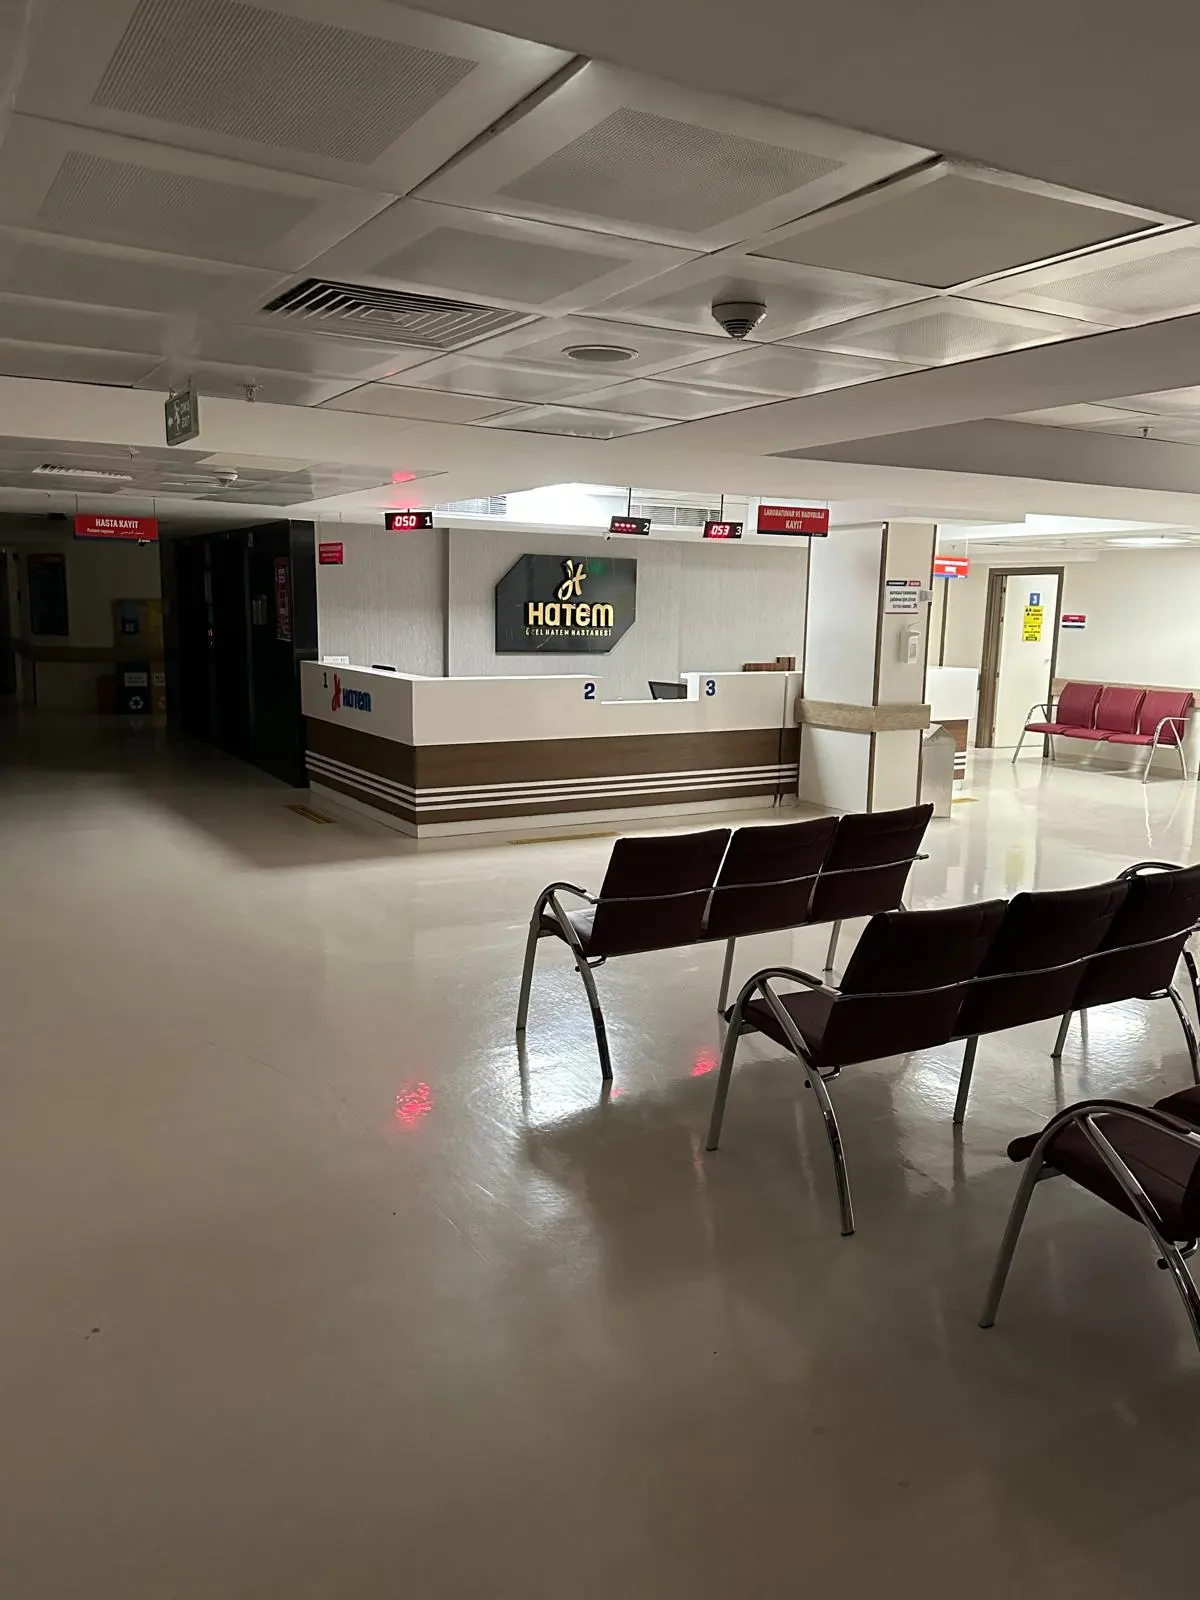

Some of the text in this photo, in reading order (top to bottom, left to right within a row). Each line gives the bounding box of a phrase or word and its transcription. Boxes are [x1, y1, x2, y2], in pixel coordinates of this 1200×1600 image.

[96, 519, 138, 529] HASTA KAYIT
[425, 516, 432, 526] 1
[785, 520, 802, 529] KAYIT
[642, 522, 650, 532] 2
[735, 526, 742, 535] 3
[545, 628, 569, 636] HATEM
[323, 672, 328, 688] 1
[584, 682, 596, 700] 2
[705, 680, 716, 696] 3
